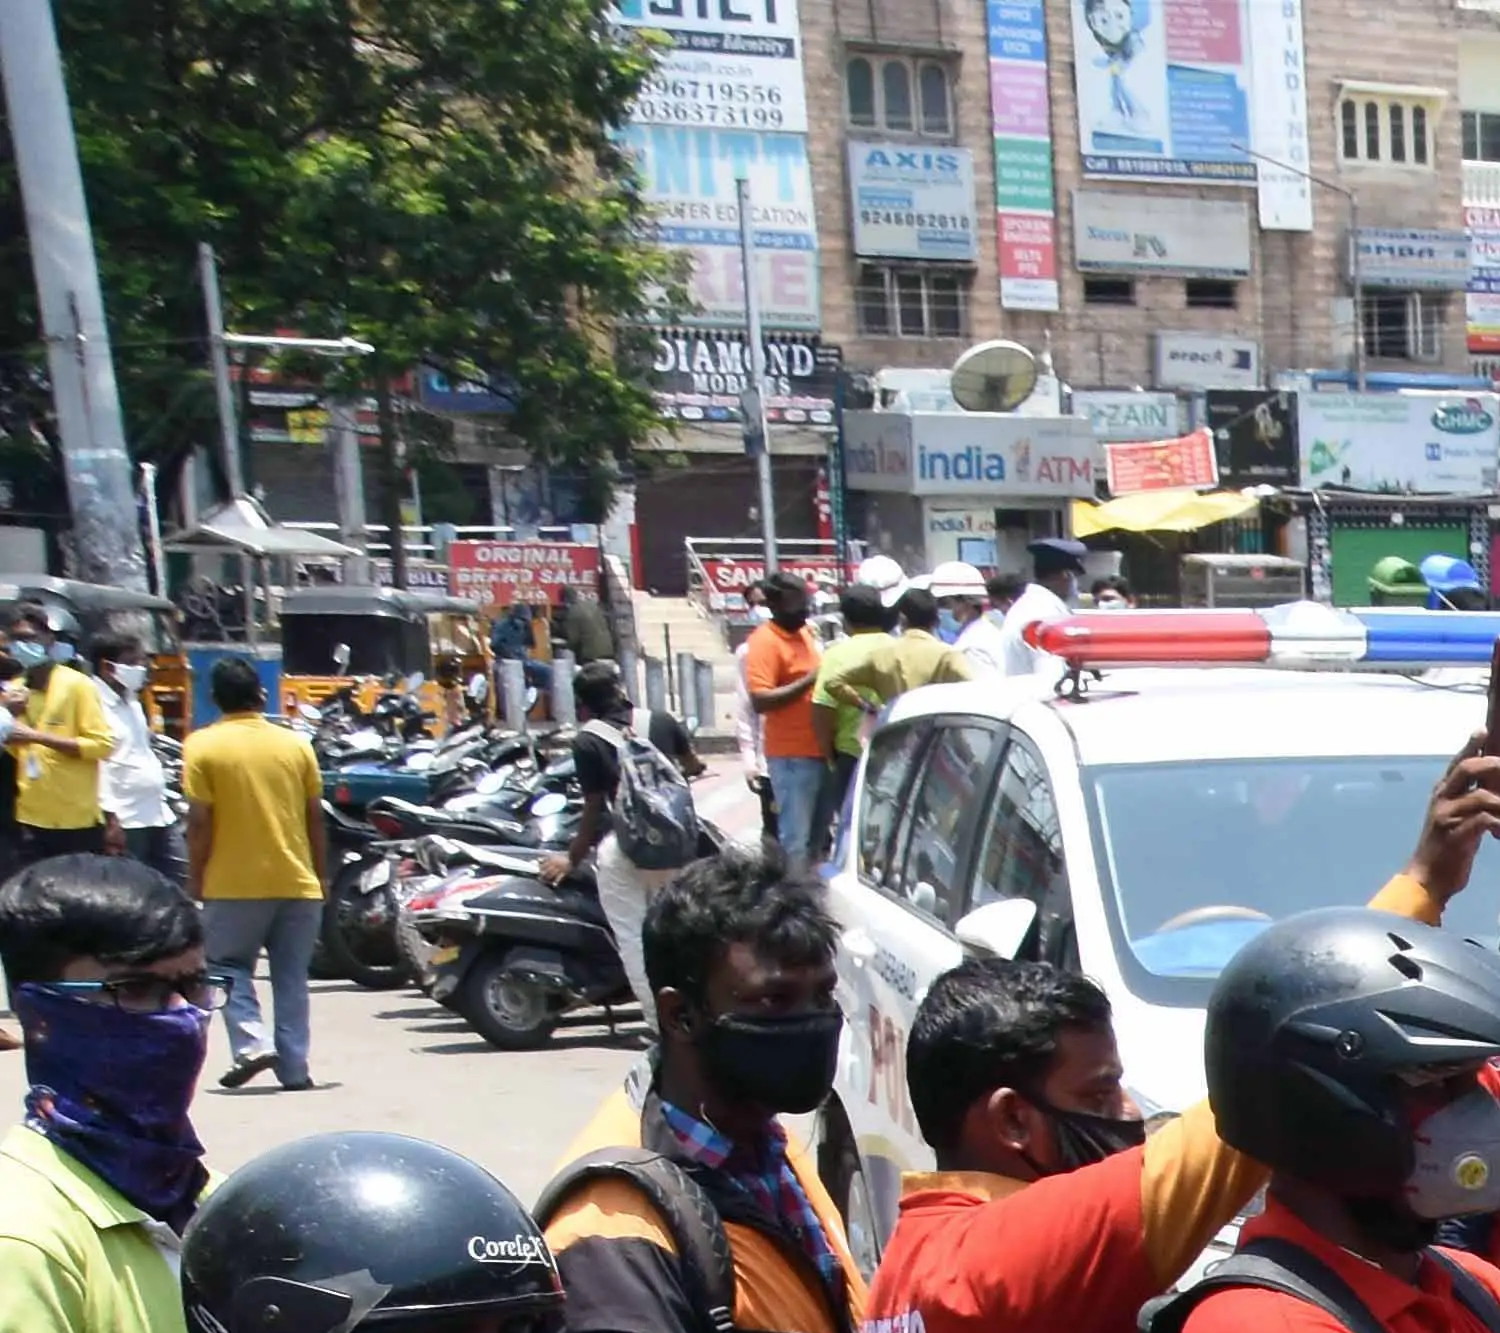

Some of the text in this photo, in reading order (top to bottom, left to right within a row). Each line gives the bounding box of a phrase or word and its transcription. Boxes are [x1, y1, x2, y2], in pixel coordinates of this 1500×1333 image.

[866, 150, 959, 171] AXIS
[716, 204, 810, 226] EDCATION
[690, 250, 806, 306] REE
[692, 373, 791, 396] MOBIES
[1109, 404, 1168, 429] ZAIN
[1435, 411, 1489, 429] GHMC
[1037, 456, 1091, 485] ATM
[475, 546, 572, 565] ORGINAL
[376, 572, 448, 587] MBILE
[456, 567, 596, 585] BRAND SALE
[716, 566, 766, 588] SAN
[467, 1234, 552, 1268] CoreleX
